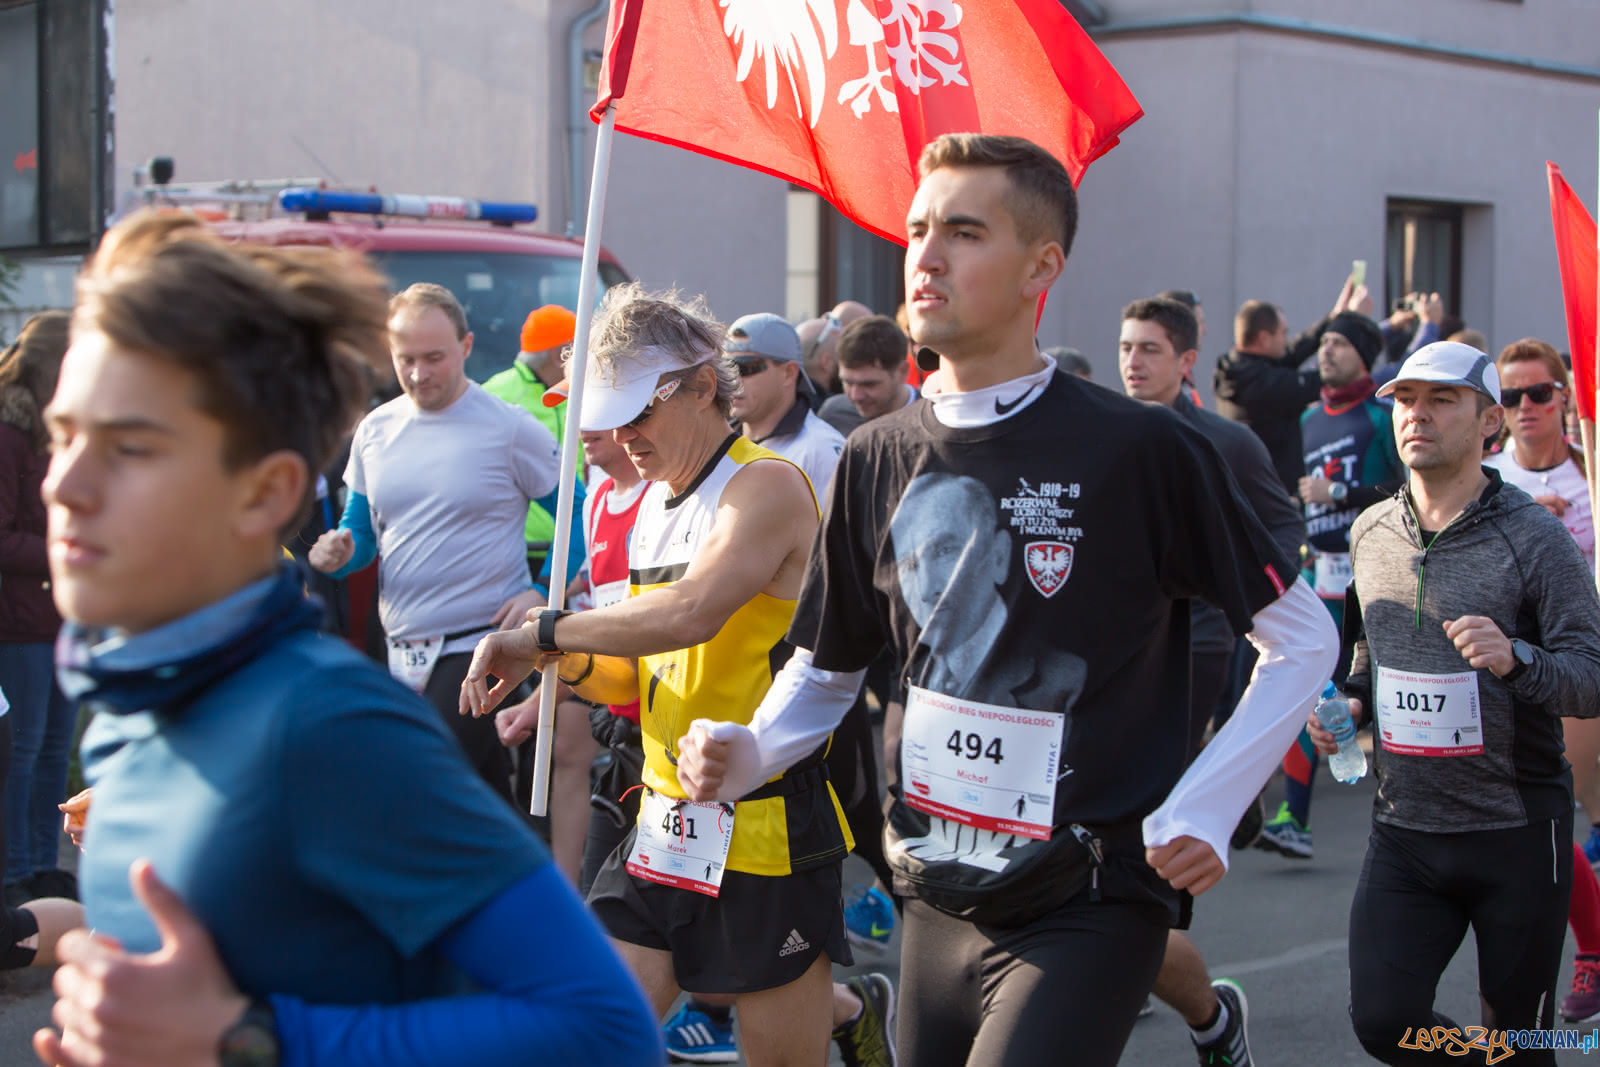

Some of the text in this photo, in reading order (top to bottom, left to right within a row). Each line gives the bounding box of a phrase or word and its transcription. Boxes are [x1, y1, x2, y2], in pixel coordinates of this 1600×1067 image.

[1395, 691, 1447, 713] 1017
[958, 705, 977, 717] BIEG
[978, 709, 1056, 728] NIEPODLEGŁOŚCI
[1409, 719, 1432, 727] Wojtek
[946, 729, 1004, 765] 494
[956, 768, 989, 785] Michał
[1046, 751, 1057, 784] STREFA
[661, 812, 698, 840] 481
[667, 843, 688, 855] Marek
[779, 942, 810, 957] adidas
